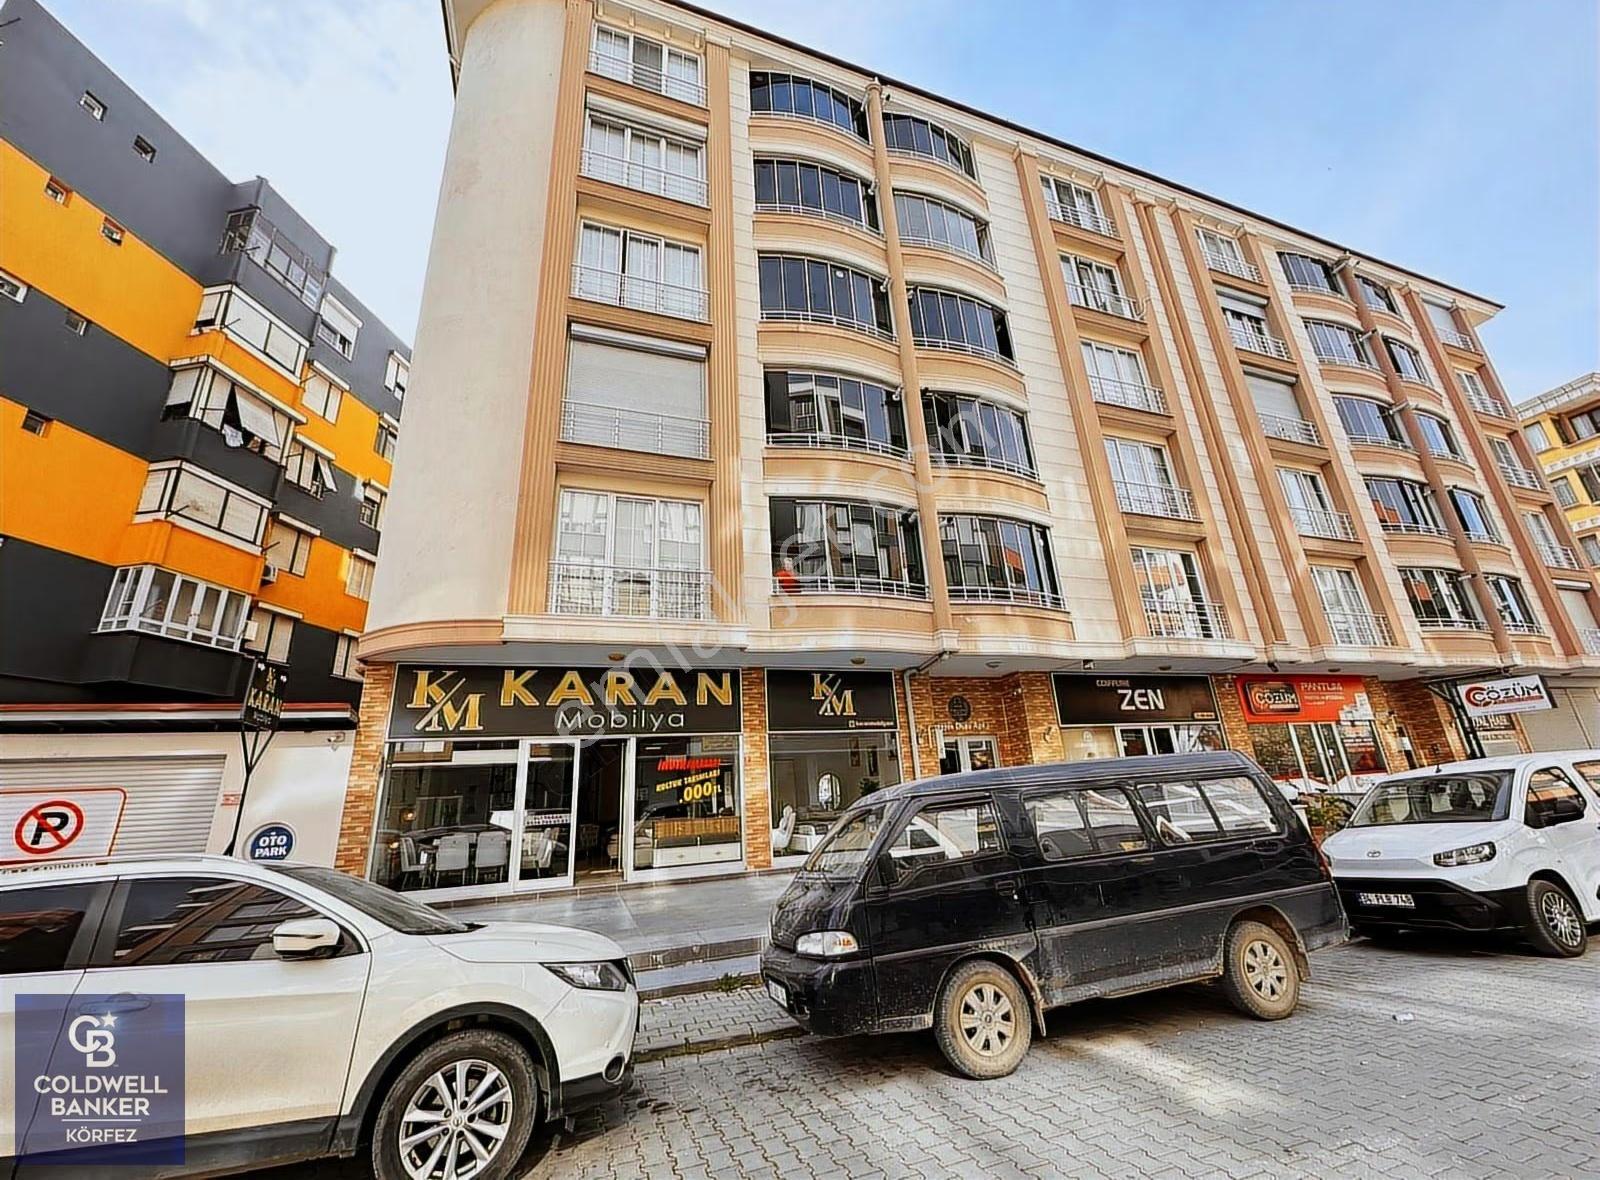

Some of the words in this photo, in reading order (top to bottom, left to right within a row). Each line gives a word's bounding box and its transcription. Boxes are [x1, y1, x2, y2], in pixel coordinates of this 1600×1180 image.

[499, 670, 733, 706] KARAN
[1117, 689, 1165, 711] ZEN
[556, 708, 685, 732] Mobilya
[254, 846, 288, 858] PARK
[259, 835, 288, 847] OTO
